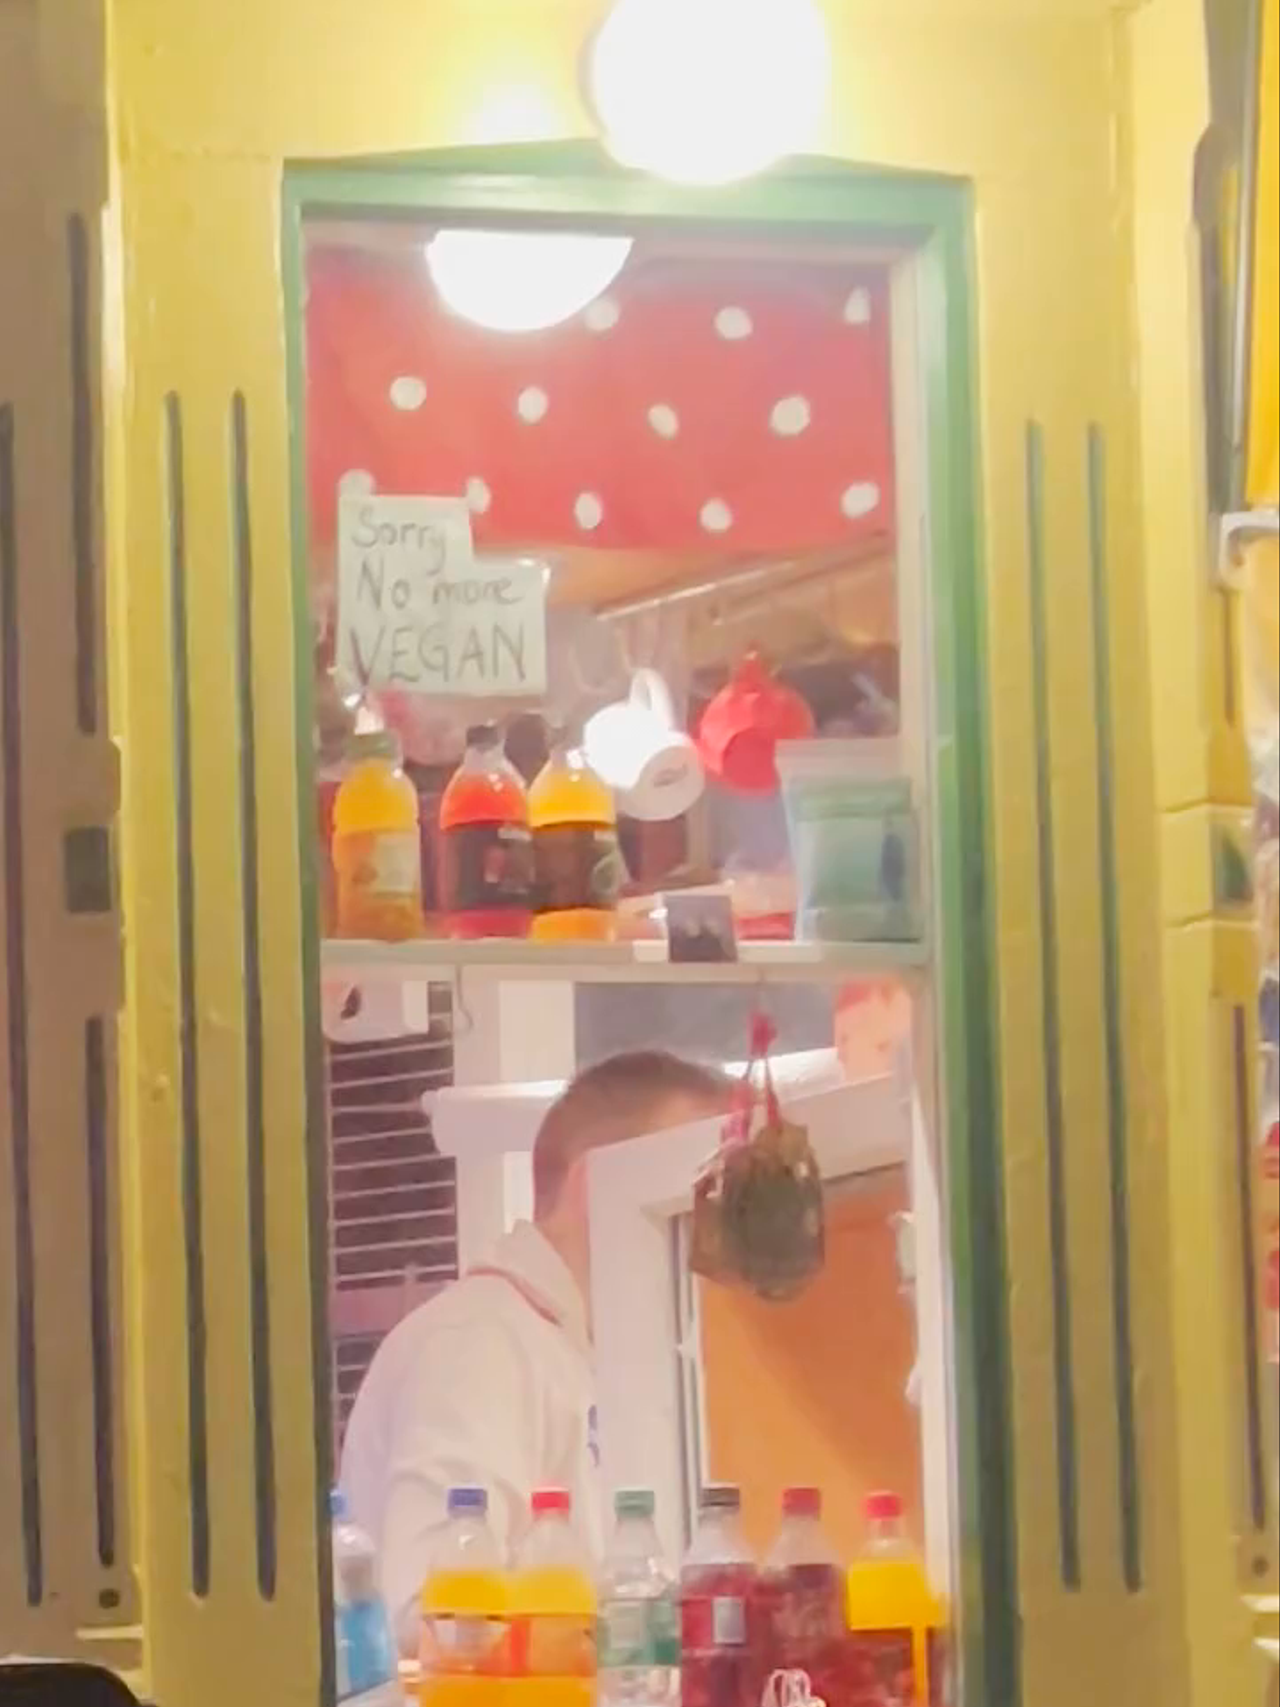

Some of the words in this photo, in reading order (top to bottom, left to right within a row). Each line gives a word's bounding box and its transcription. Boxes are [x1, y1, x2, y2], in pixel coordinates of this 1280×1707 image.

[351, 504, 447, 577] Sorry
[356, 556, 410, 611] No
[432, 574, 524, 606] more
[349, 622, 527, 687] VEGAN
